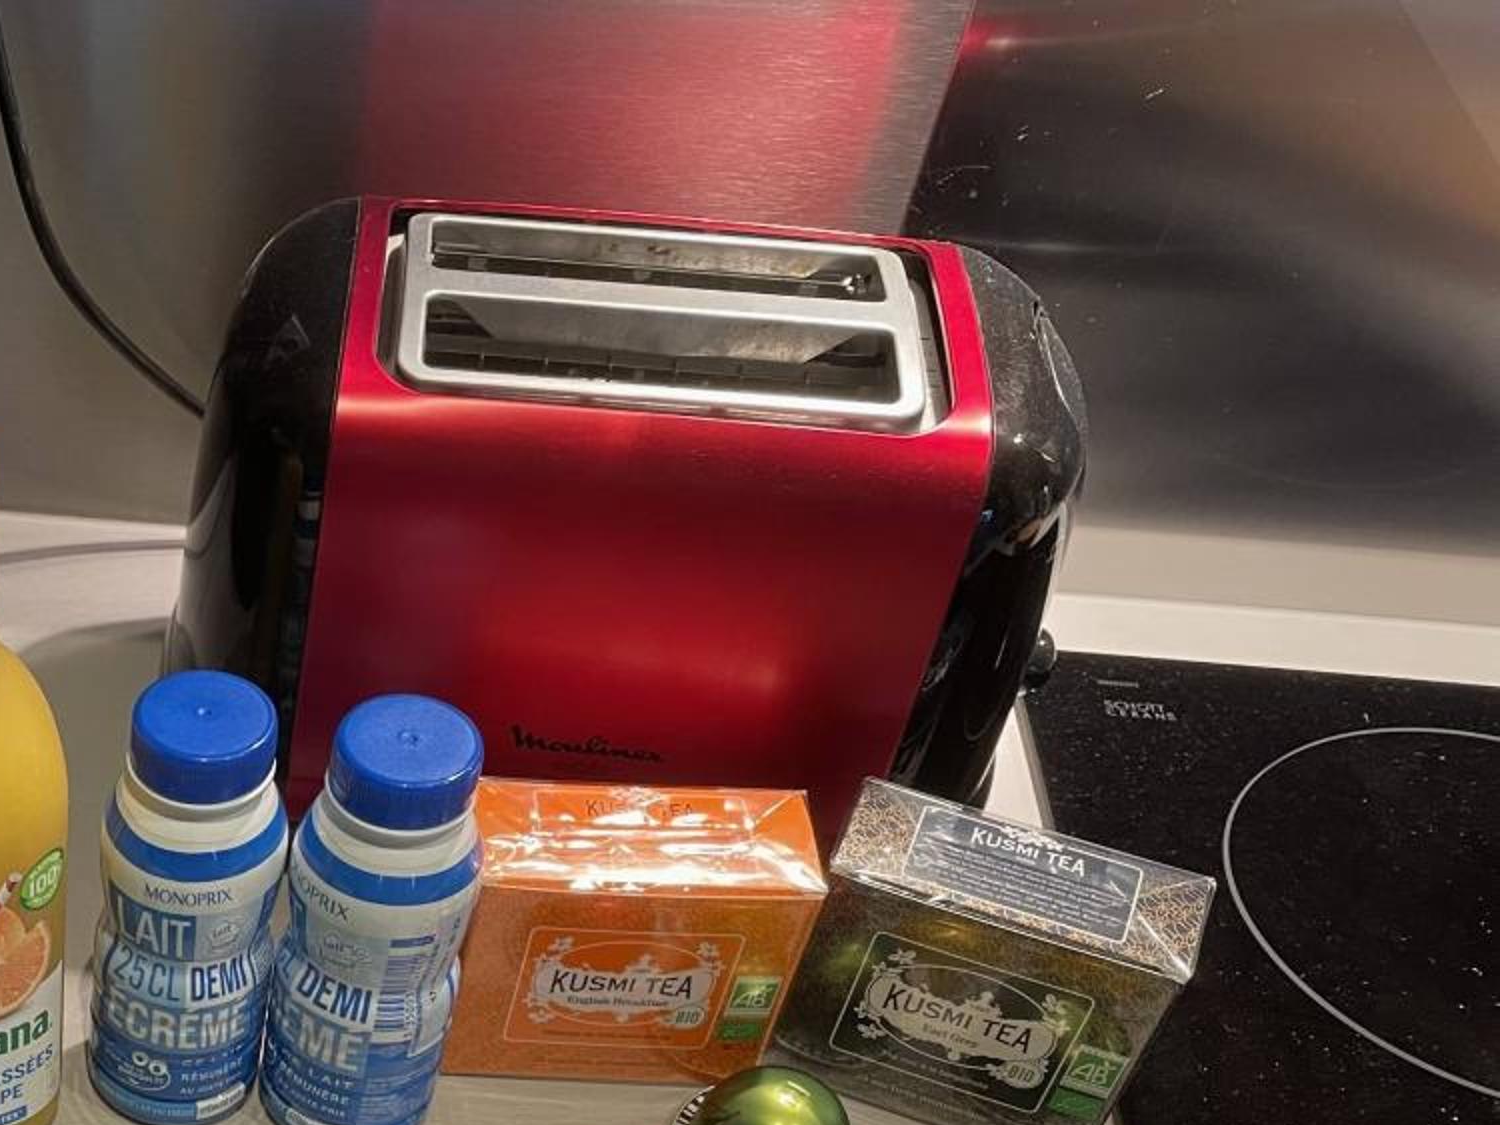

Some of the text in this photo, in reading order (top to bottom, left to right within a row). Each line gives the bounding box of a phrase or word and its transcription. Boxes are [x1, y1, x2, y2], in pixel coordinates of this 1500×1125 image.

[971, 827, 1086, 878] KUSMI TEA
[144, 882, 233, 908] MONOPRIX
[116, 895, 192, 960] LAIT
[190, 953, 248, 1002] DEMI
[296, 962, 373, 1025] DEMI
[549, 968, 694, 999] KUSMI TEA
[882, 983, 1032, 1054] KUSMI TEA
[1006, 1062, 1034, 1083] BIO
